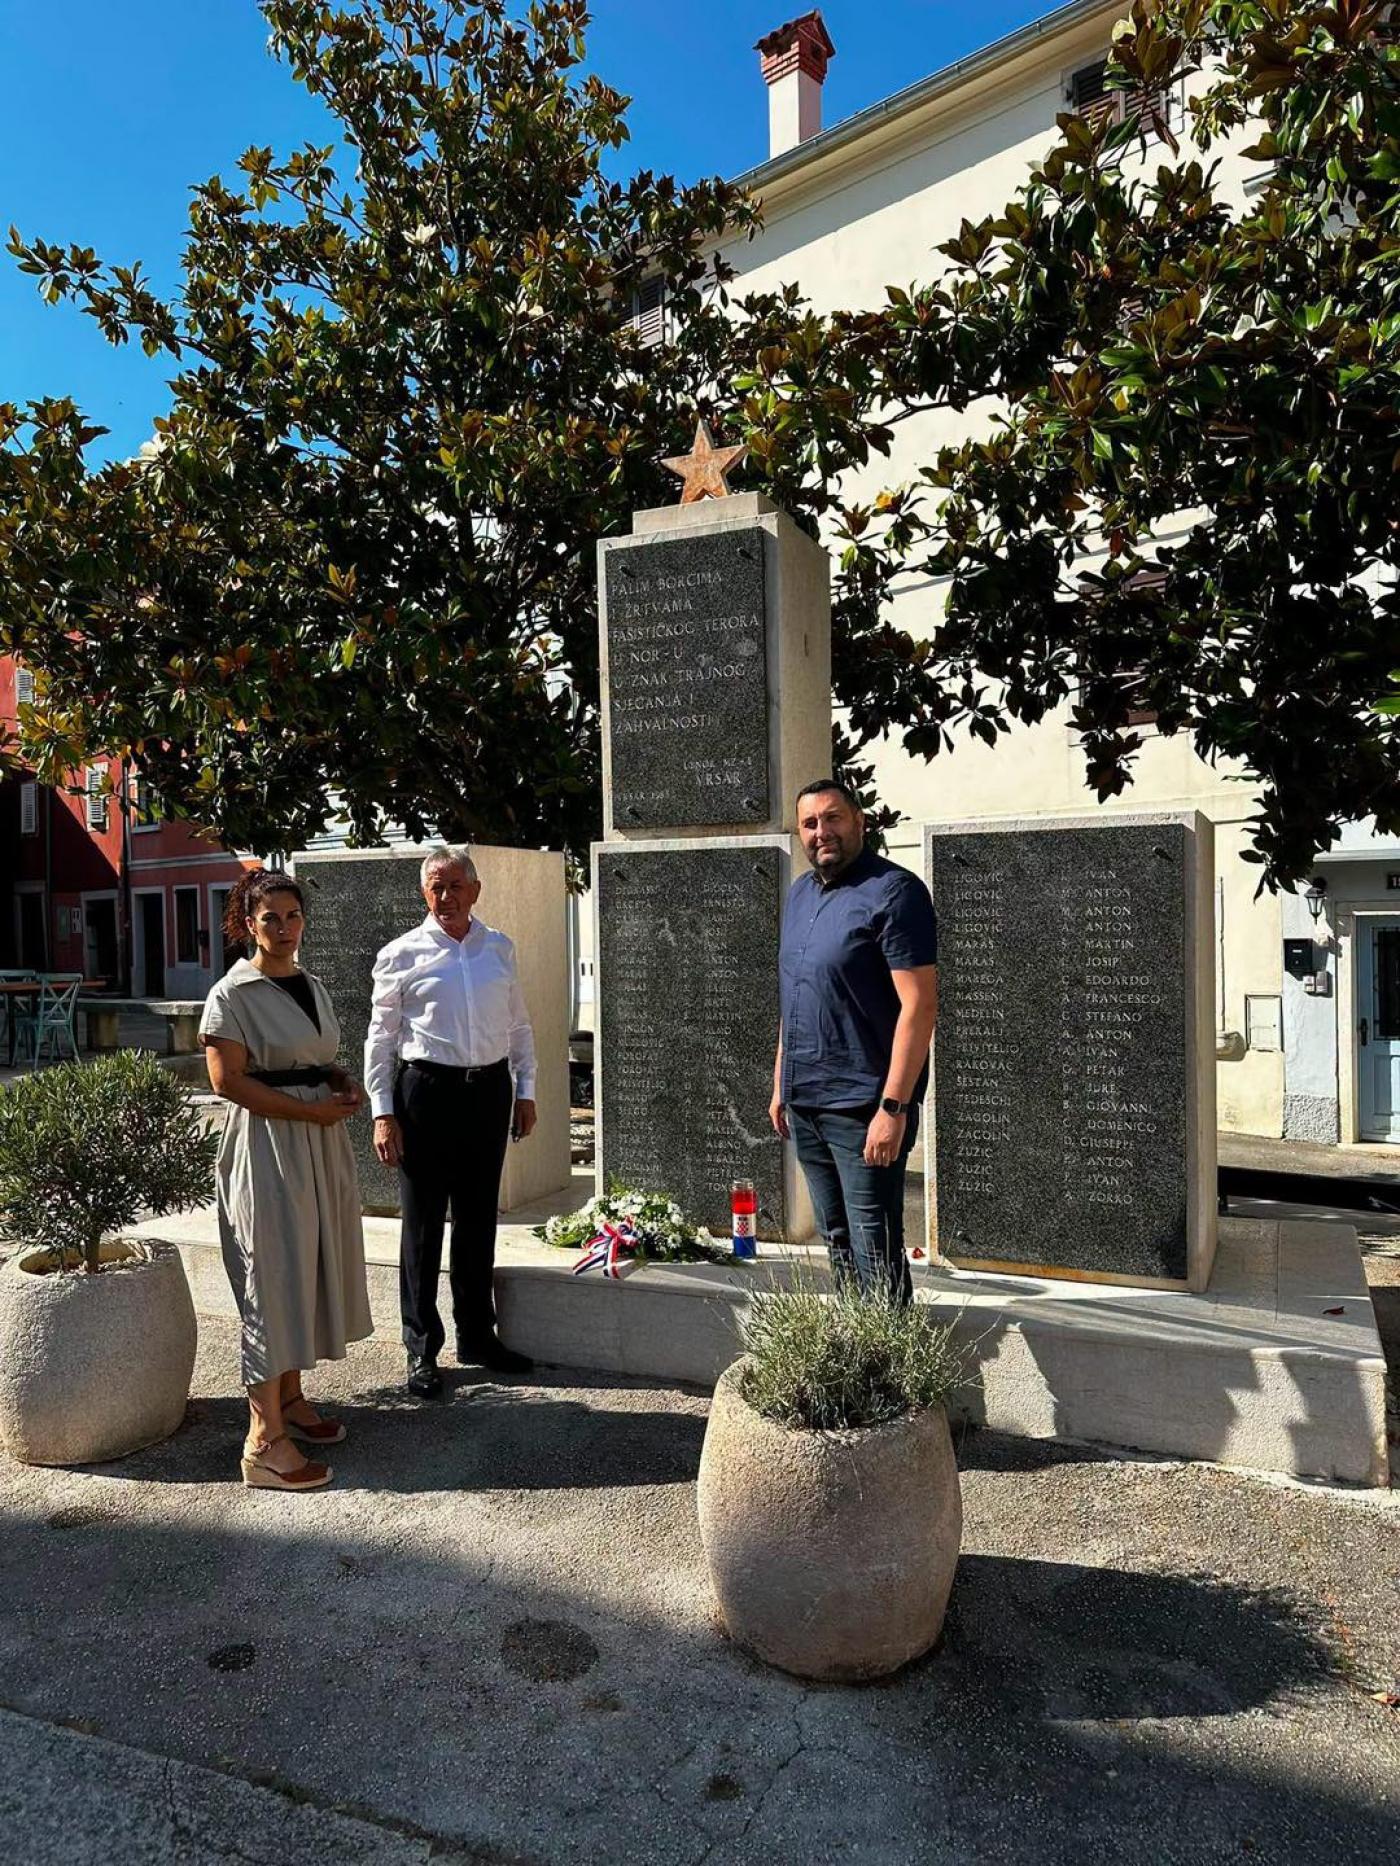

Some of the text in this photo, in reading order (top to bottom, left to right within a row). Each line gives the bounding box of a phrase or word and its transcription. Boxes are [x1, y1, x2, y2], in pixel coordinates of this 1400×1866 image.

[611, 580, 650, 597] PALIM
[704, 614, 760, 633] TERORA
[630, 648, 660, 664] NOR
[631, 671, 669, 688] ZNAK
[674, 663, 746, 684] TRAJNOG
[1085, 888, 1132, 900] ANTON
[1085, 906, 1132, 917] ANTON
[1085, 922, 1132, 933] ANTON
[1085, 957, 1121, 967] JOSIP
[1085, 975, 1151, 987] EDOARDO
[1085, 992, 1162, 1005] FRANCESCO
[1085, 1011, 1143, 1023] STEFANO
[1085, 1029, 1132, 1041] ANTON
[1086, 1046, 1118, 1058] IVAN
[1087, 1064, 1124, 1077] PETAR
[1087, 1100, 1152, 1114] GIOVANNI
[1087, 1119, 1157, 1134] DOMENICO
[1080, 1136, 1135, 1150] GIUSEPPE
[1087, 1156, 1134, 1168] ANTON
[1087, 1174, 1119, 1186] IVAN
